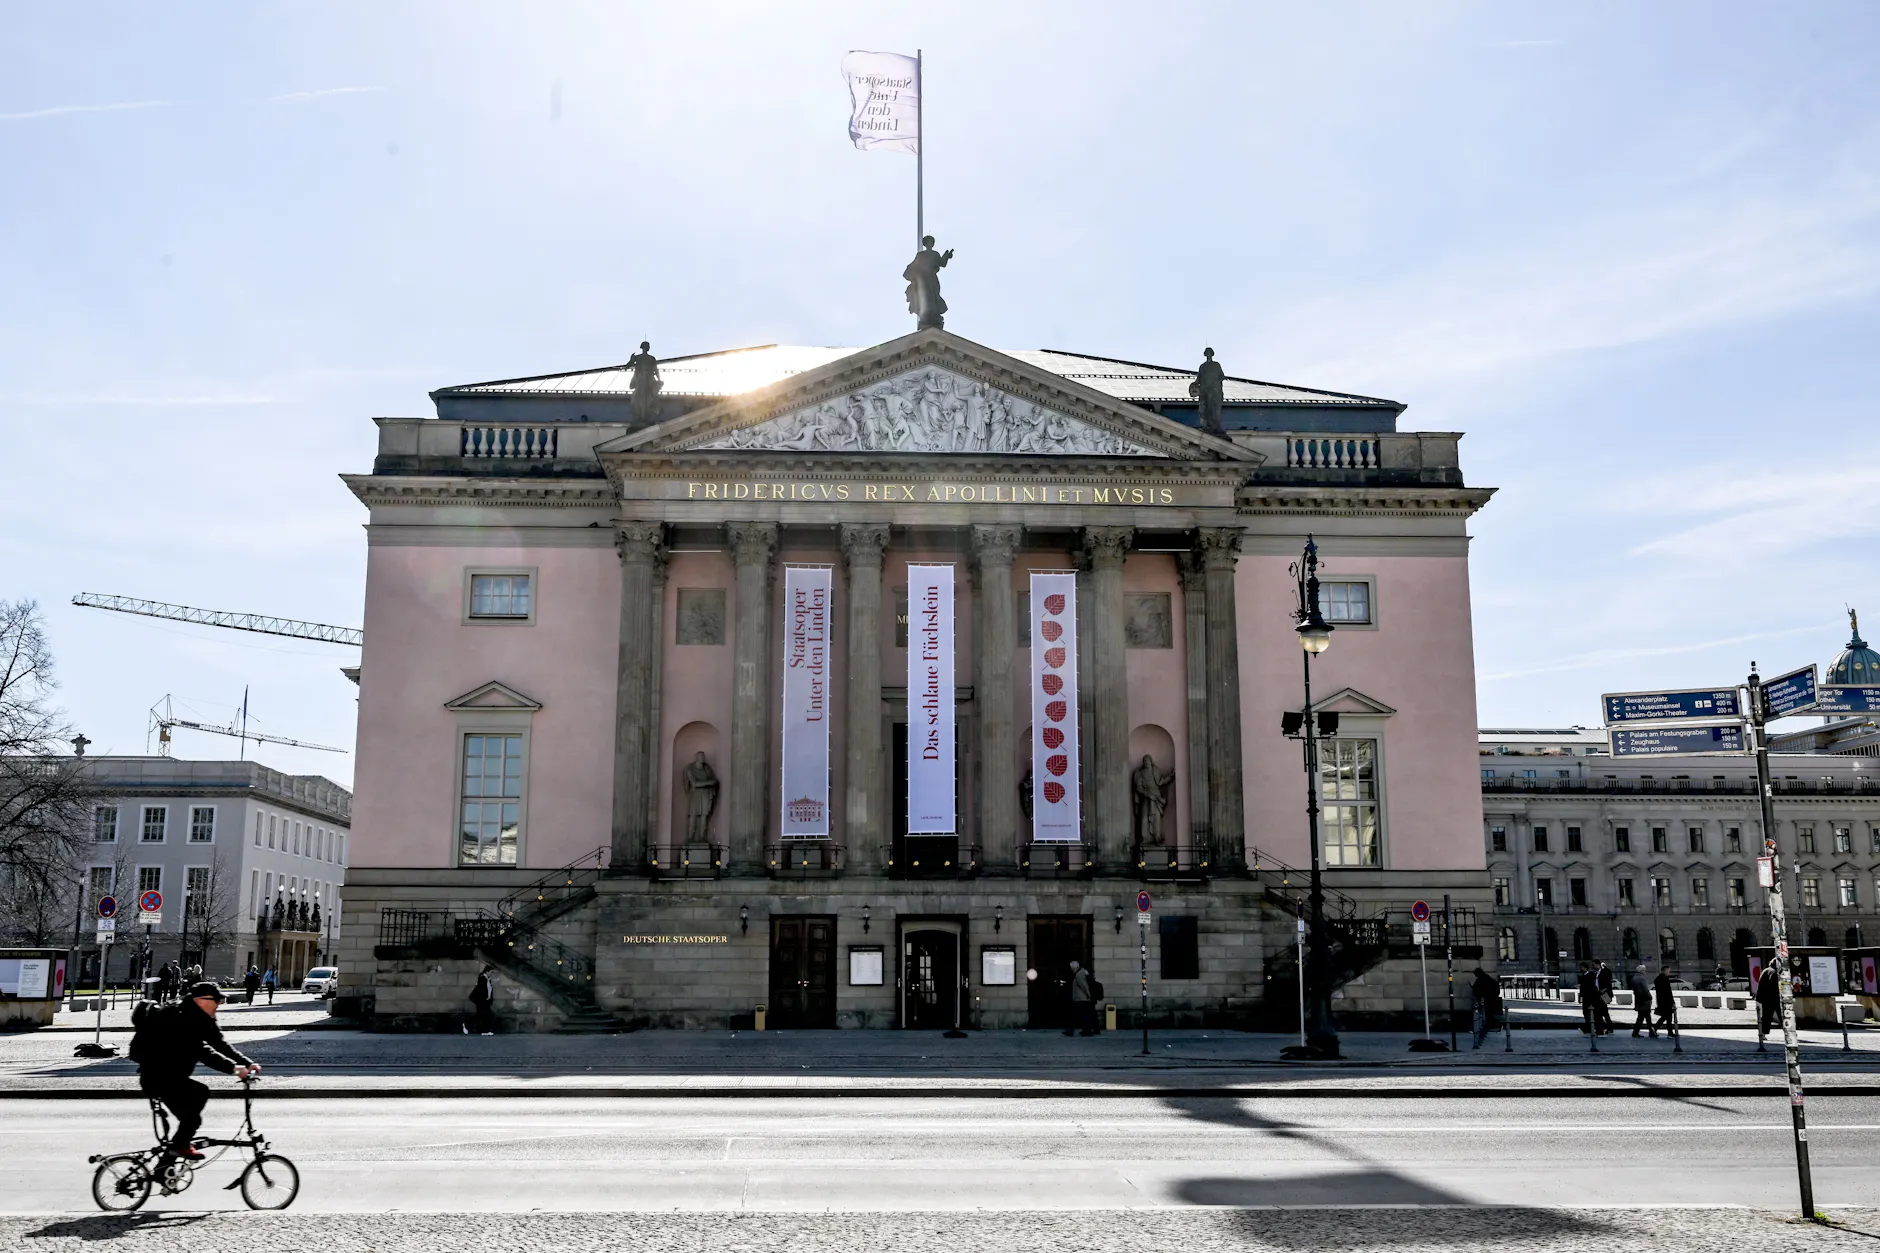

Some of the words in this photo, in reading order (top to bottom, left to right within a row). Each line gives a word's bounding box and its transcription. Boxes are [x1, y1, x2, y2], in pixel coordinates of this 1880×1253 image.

[688, 482, 850, 500] FRIDERICVS
[864, 485, 916, 501] REX
[926, 485, 1048, 502] APOLLINI
[1058, 489, 1084, 502] ET
[1093, 488, 1174, 504] MVSIS
[789, 588, 810, 668] Staatsoper
[807, 588, 824, 642] Linden
[922, 586, 939, 661] Füchslein
[806, 646, 823, 675] den
[806, 678, 823, 722] Unter
[922, 666, 939, 725] schlaue
[1624, 696, 1668, 704] Alexanderplatz
[1626, 710, 1688, 718] Maxim-Gorki-Theater
[923, 729, 939, 761] Das
[1660, 730, 1707, 738] Festungsgraben
[623, 935, 671, 944] DEUTSCHE
[672, 935, 728, 944] STAATSOPER
